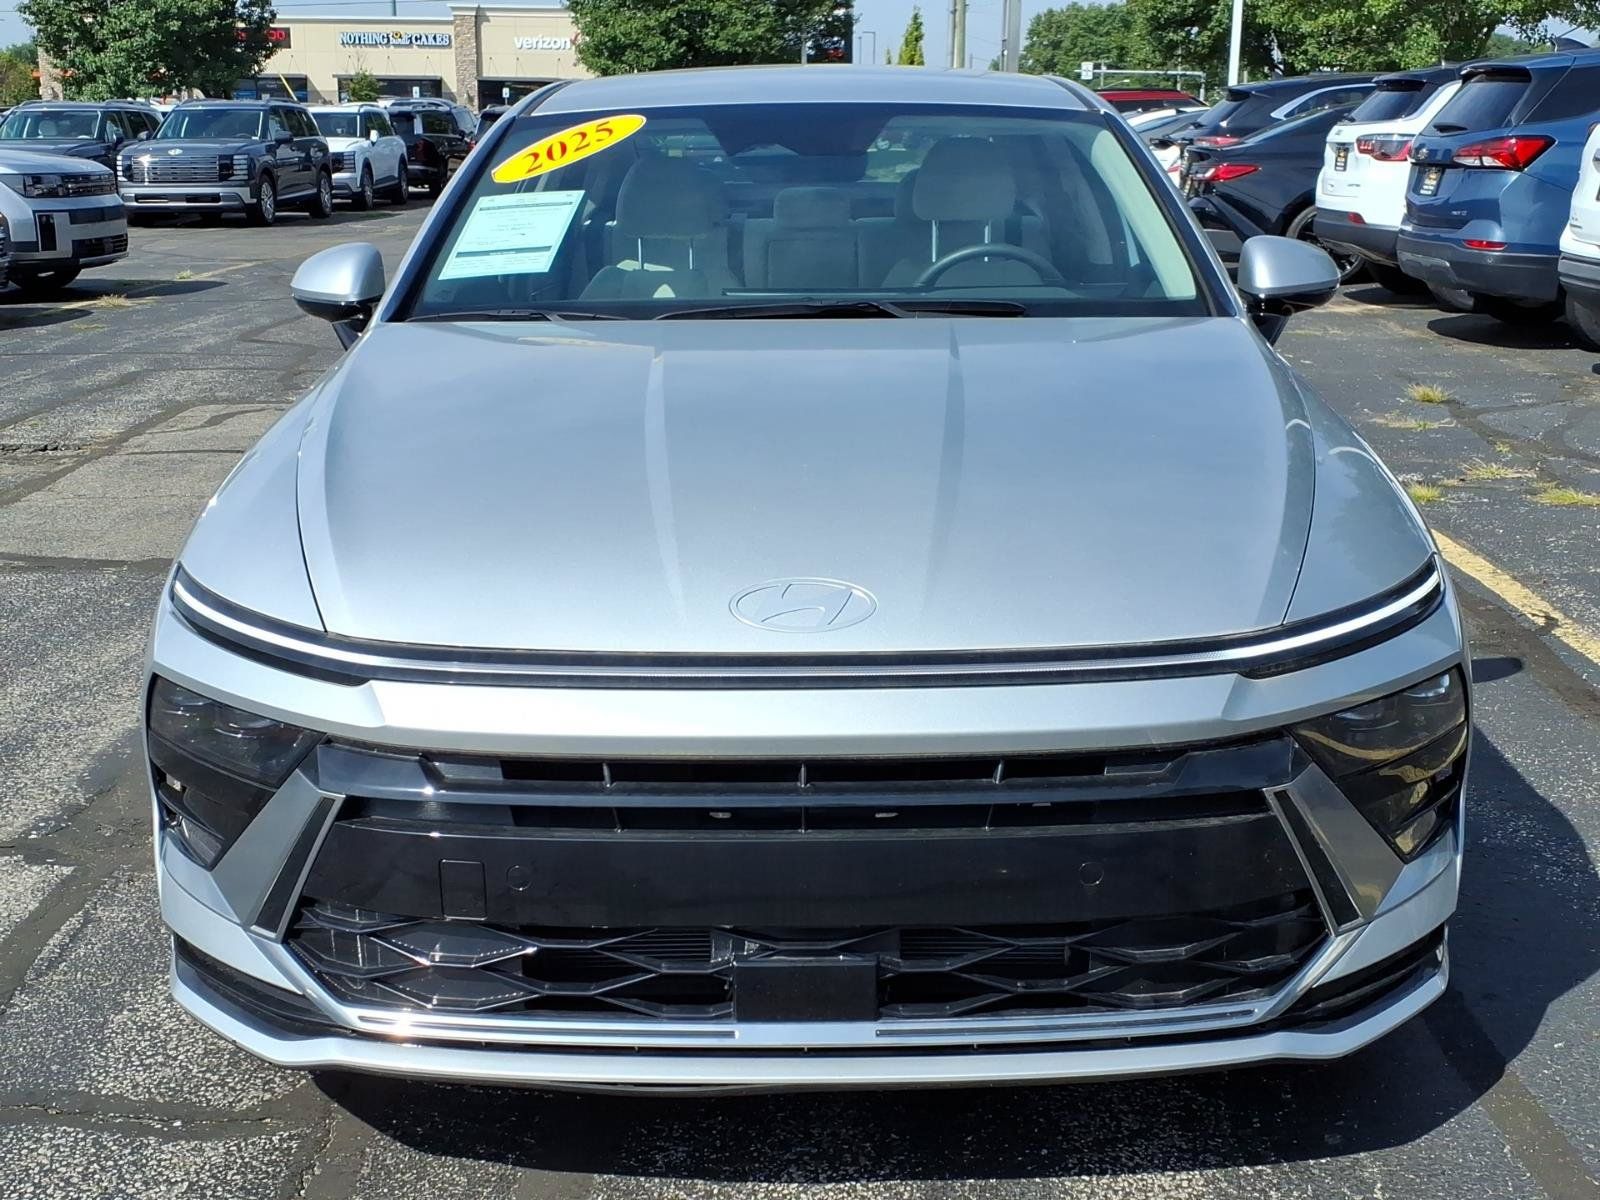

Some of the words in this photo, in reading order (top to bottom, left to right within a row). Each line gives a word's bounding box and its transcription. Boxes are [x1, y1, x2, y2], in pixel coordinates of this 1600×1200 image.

[339, 32, 388, 46] NOTHING
[412, 34, 451, 47] CAKES
[514, 34, 571, 49] verizon
[524, 121, 613, 174] 2025
